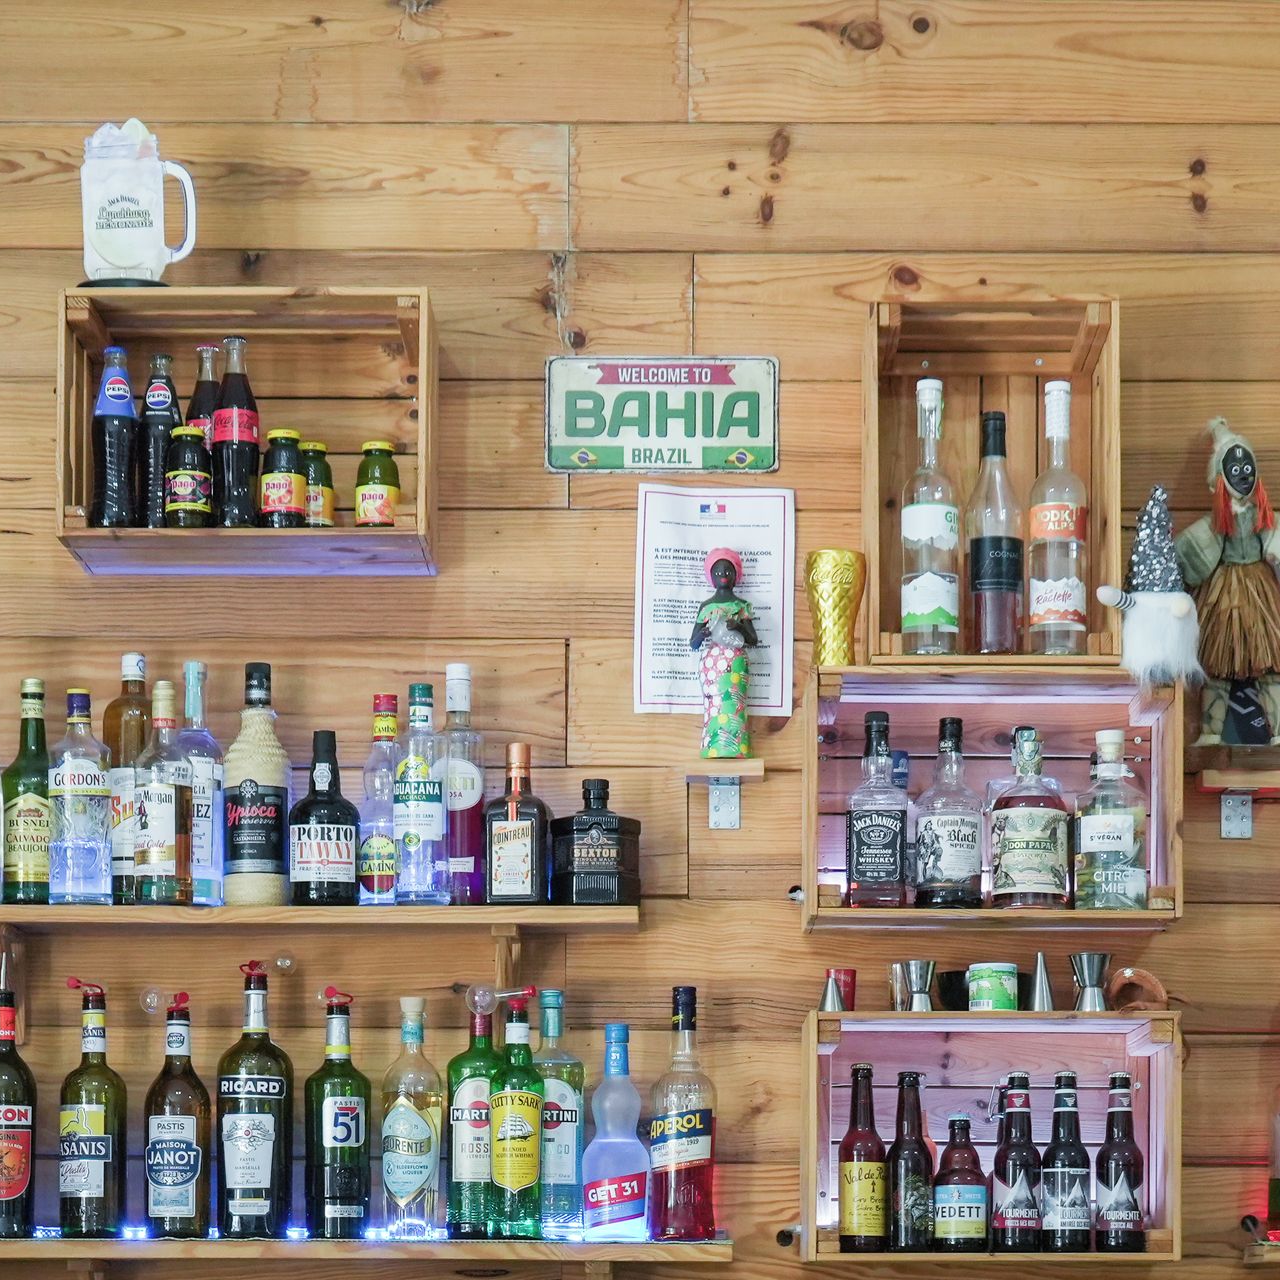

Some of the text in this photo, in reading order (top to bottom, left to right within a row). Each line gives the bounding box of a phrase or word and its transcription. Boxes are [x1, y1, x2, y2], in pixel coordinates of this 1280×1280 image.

[95, 219, 153, 230] LEMONADE
[618, 368, 711, 384] WELCOME TO
[106, 386, 130, 394] PEPSI
[147, 392, 171, 400] PEPSI
[565, 391, 760, 438] BAHIA
[632, 448, 692, 465] BRAZIL
[171, 479, 196, 490] pago
[265, 481, 288, 491] pago
[361, 491, 384, 502] pago
[54, 772, 106, 787] GORDON'S
[142, 790, 174, 804] Morgan
[853, 813, 903, 833] JACK DANIEL'S
[936, 817, 959, 830] Captain
[296, 826, 354, 842] PORTO
[493, 826, 531, 846] COINTREAU
[947, 829, 978, 844] Black
[1096, 833, 1122, 842] VÉRAN
[296, 841, 354, 860] TAWNY
[860, 846, 893, 855] Tennessee
[949, 842, 976, 850] SPICED
[1008, 840, 1052, 850] DON PAPA
[573, 848, 618, 858] SEXTON
[220, 1080, 280, 1093] RICARD
[491, 1095, 540, 1111] CUTTY SARK
[156, 1122, 185, 1131] PASTIS
[332, 1112, 360, 1144] 51
[649, 1112, 704, 1140] APEROL
[155, 1141, 187, 1150] MAISON
[147, 1150, 197, 1166] JANOT
[844, 1167, 875, 1185] Val de
[587, 1180, 639, 1202] GET 31
[935, 1205, 982, 1218] VEDETT
[1002, 1208, 1039, 1218] TOURMENTE
[1103, 1210, 1140, 1221] TOURMENTE
